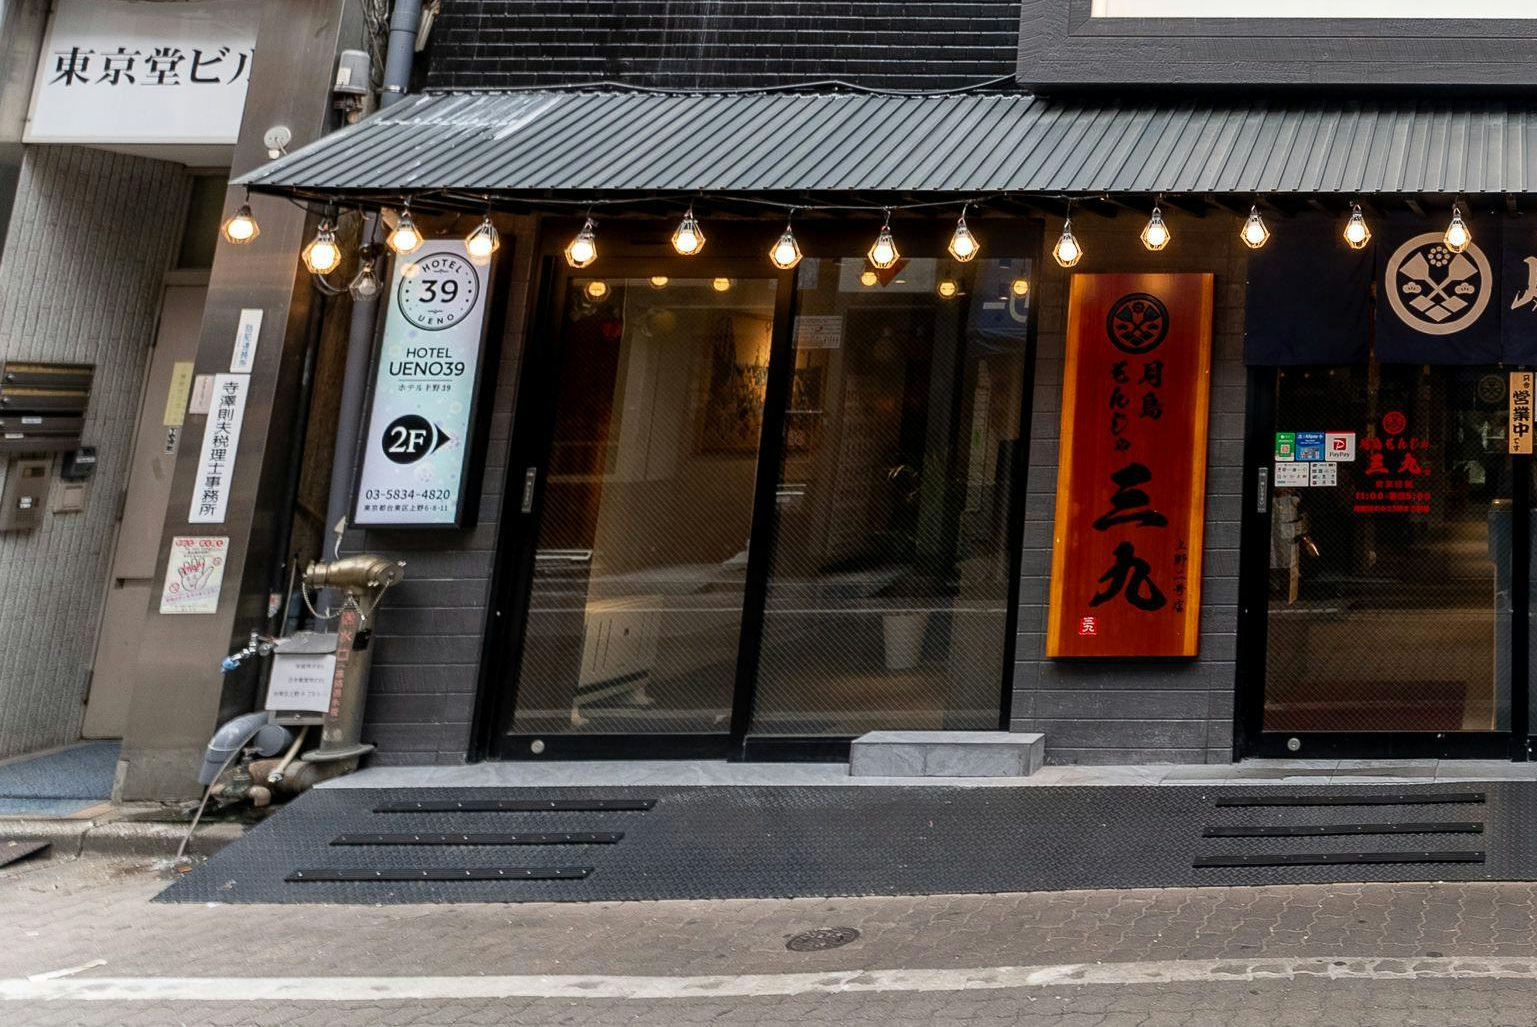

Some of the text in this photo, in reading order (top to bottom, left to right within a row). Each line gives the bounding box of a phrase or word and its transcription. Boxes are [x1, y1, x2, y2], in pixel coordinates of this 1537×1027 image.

[422, 258, 462, 273] HOTEL
[418, 280, 459, 303] 39
[418, 314, 454, 325] UENO
[406, 347, 453, 359] HOTEL
[389, 362, 465, 377] UENO39
[1137, 360, 1164, 420] 月島
[389, 426, 427, 453] 2F
[365, 489, 450, 500] 03-5834-4820
[1089, 462, 1167, 611] 三九
